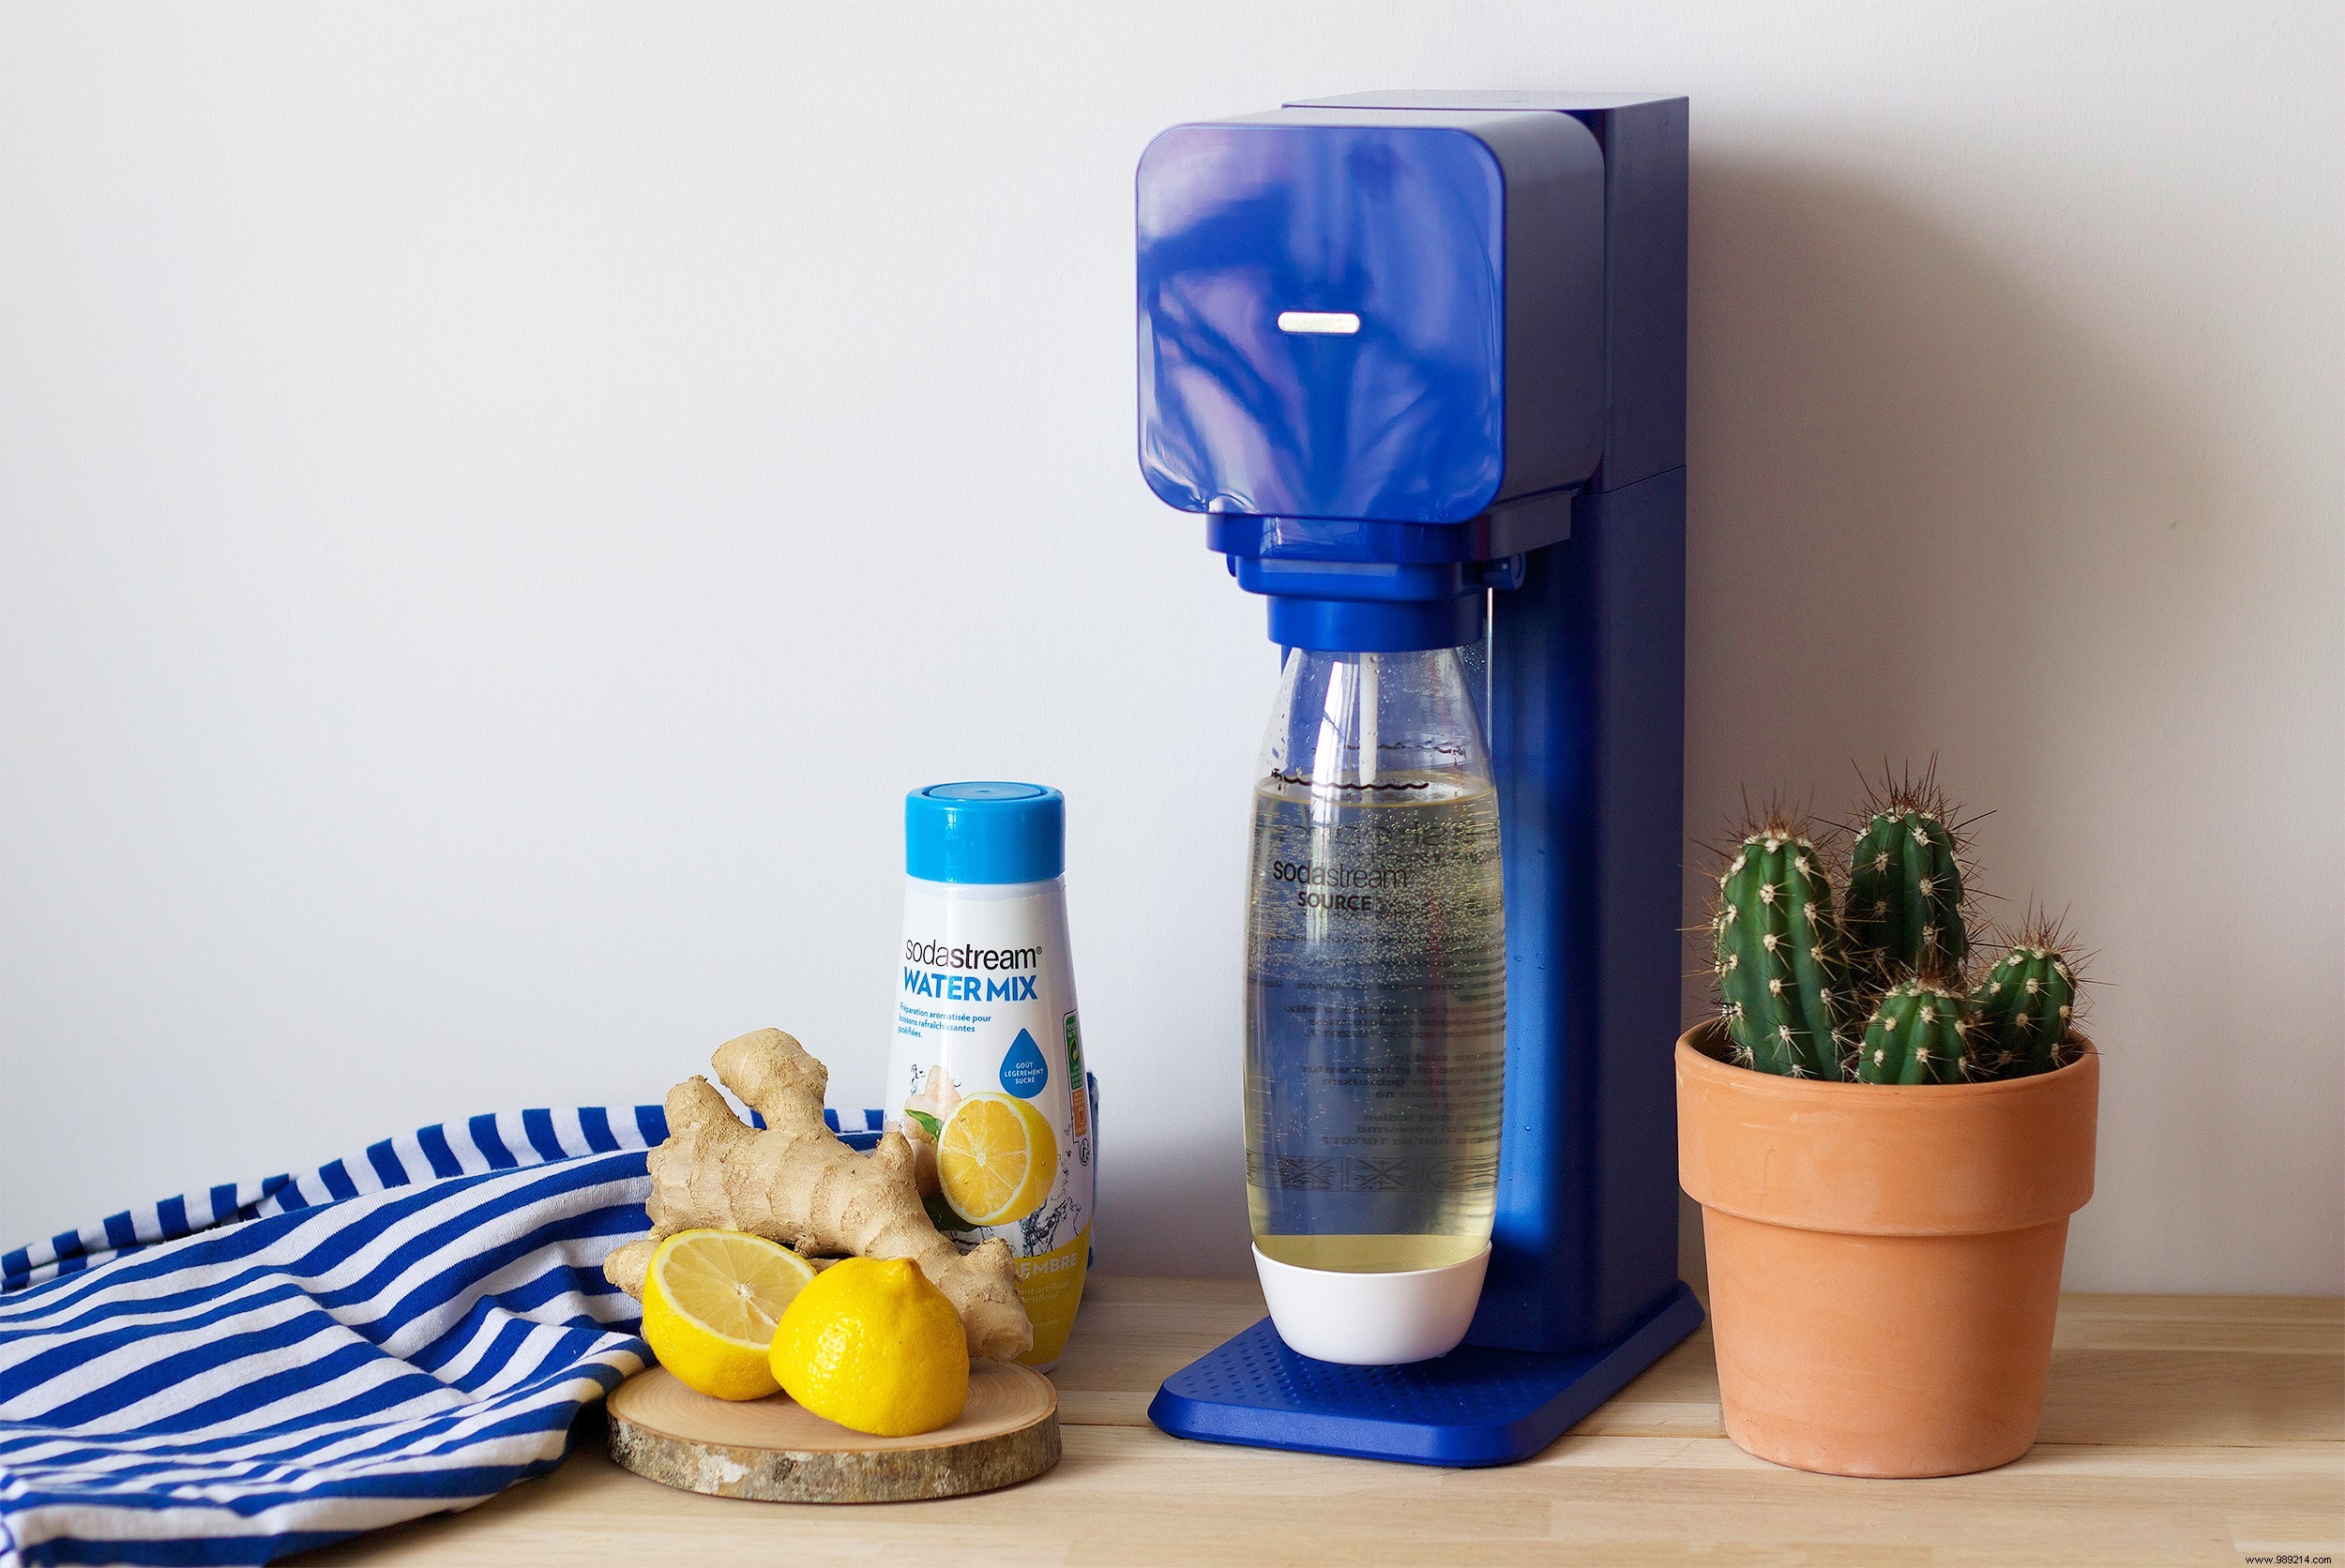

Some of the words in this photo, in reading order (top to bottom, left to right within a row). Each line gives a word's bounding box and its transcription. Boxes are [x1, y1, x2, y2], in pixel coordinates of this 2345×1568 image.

[1273, 861, 1408, 888] sodastream
[1297, 891, 1372, 912] SOURCE
[904, 966, 982, 1003] WATER
[986, 975, 1038, 1003] MIX
[929, 1012, 971, 1022] aromatisée
[972, 1015, 991, 1024] pour
[1004, 1068, 1044, 1078] LÉGÈREMENT
[1015, 1061, 1034, 1069] GOÛT
[1015, 1076, 1036, 1085] SUCRÉ
[1020, 1252, 1078, 1276] EMBRE
